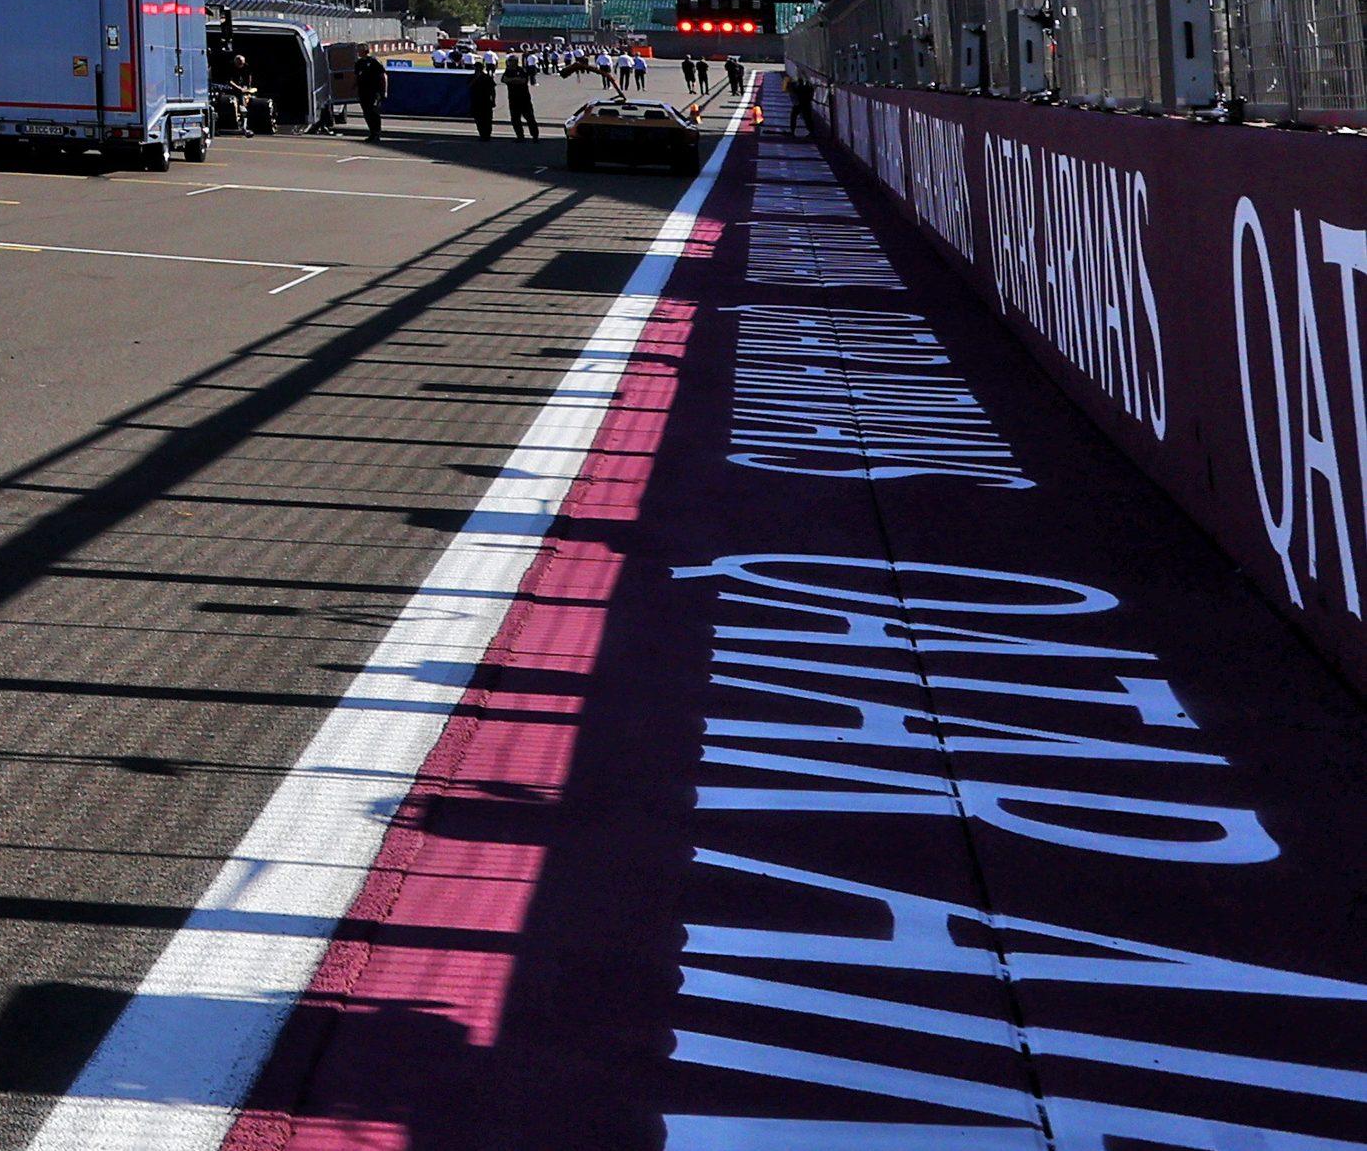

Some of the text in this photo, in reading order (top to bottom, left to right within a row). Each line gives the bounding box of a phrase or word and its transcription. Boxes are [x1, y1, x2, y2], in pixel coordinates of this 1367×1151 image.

[717, 304, 952, 364] QATAR
[985, 131, 1045, 335] QATAR
[1041, 147, 1166, 442] AIRWAYS
[725, 358, 1038, 490] AIRWAYS
[669, 553, 1281, 864] QATAR
